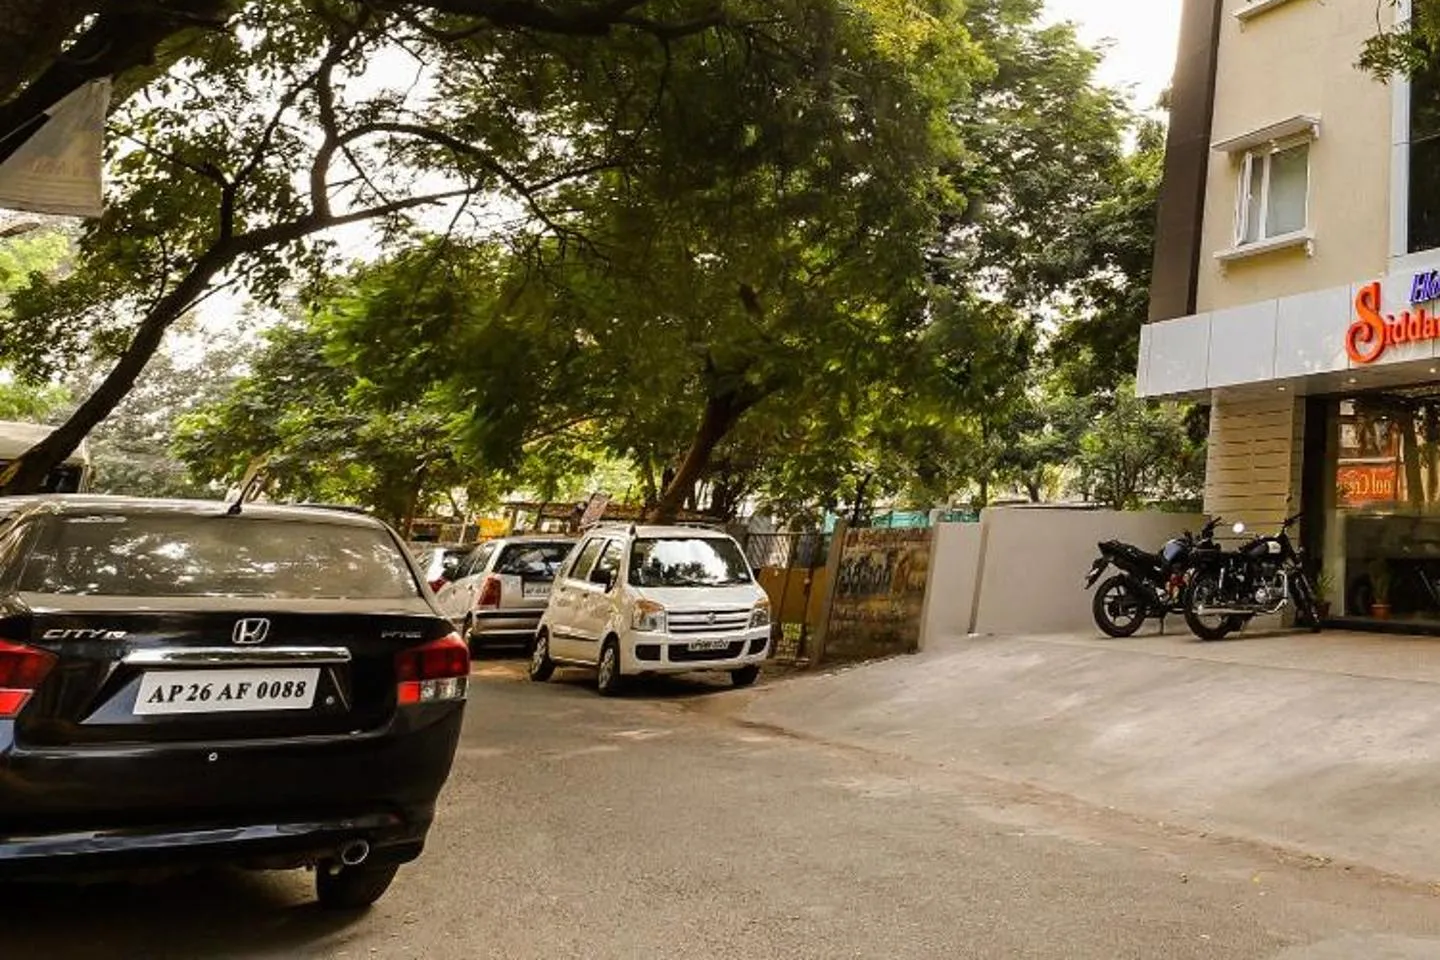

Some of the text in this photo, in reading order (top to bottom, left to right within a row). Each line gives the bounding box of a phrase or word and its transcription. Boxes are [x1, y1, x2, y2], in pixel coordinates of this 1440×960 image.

[42, 628, 107, 639] CITY
[147, 681, 307, 703] AP 26 AF 0088
